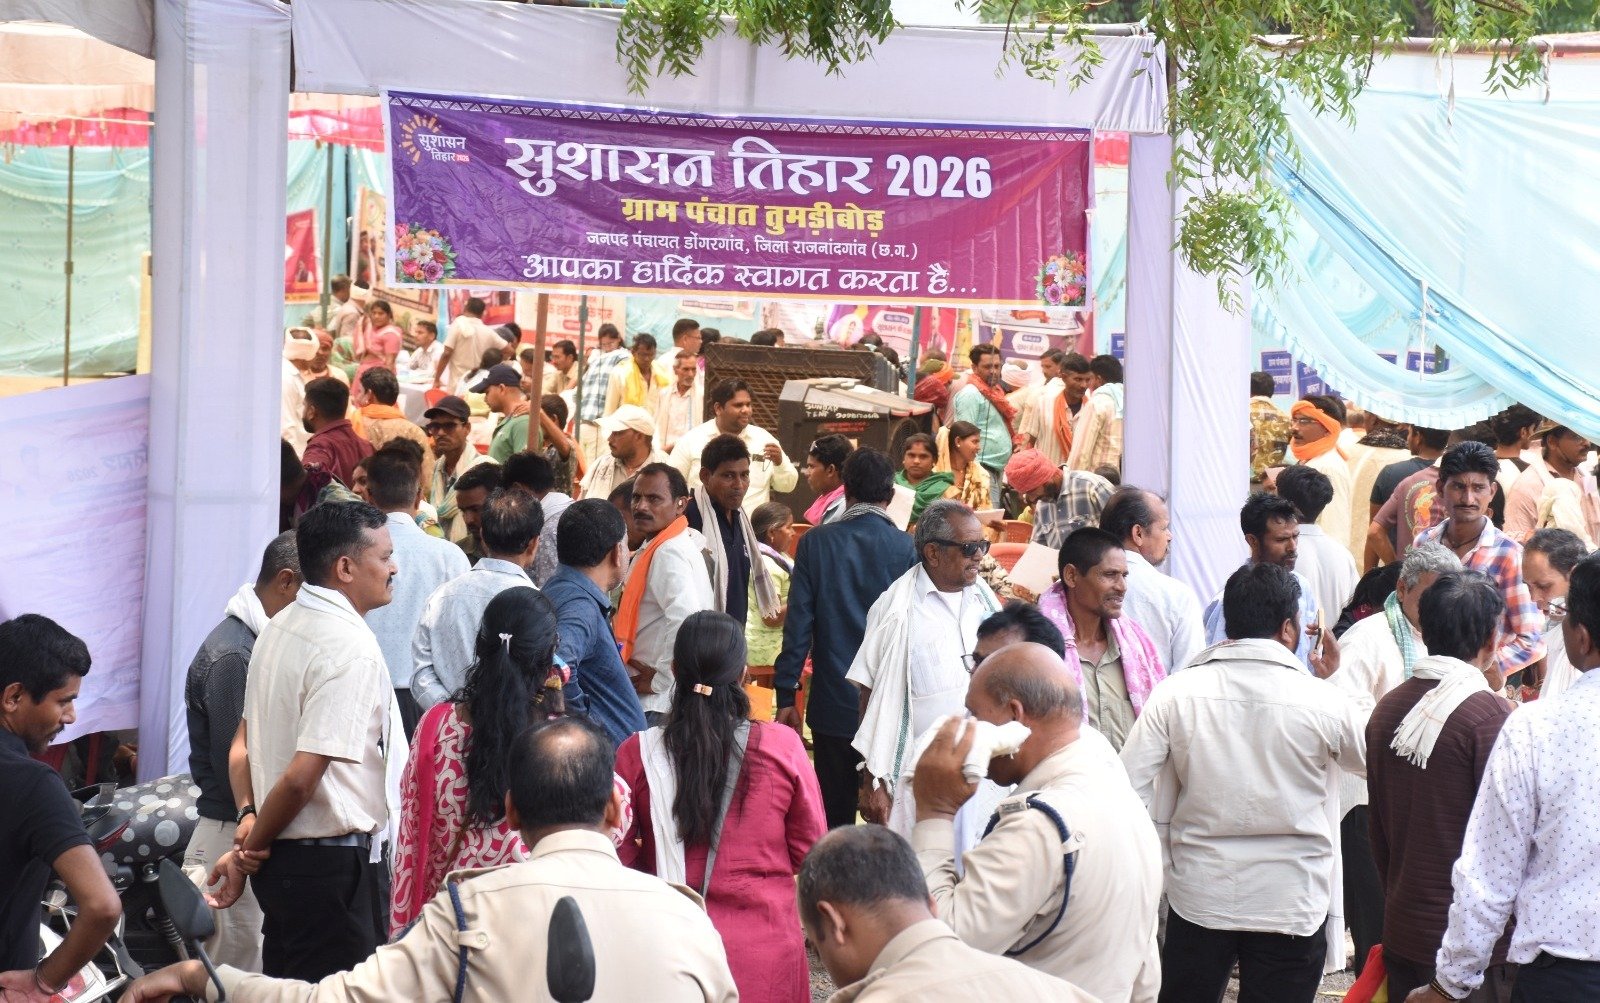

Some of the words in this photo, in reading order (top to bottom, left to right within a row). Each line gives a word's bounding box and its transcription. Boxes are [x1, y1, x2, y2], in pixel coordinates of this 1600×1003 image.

[418, 133, 466, 151] सुशासन
[431, 147, 456, 162] तिहार
[505, 137, 715, 197] सुशासन
[728, 136, 873, 195] तिहार
[886, 154, 992, 199] 2026
[621, 198, 679, 222] ग्राम
[685, 196, 759, 226] पंचात
[764, 201, 885, 238] तुमड़ीबोड़
[586, 231, 629, 247] जनपद
[632, 230, 680, 249] पंचायत
[684, 231, 750, 255] डोंगरगांव,
[754, 234, 789, 254] जिला
[793, 238, 867, 256] राजनांदगांव
[871, 241, 918, 260] (छ.ग.)
[521, 253, 624, 280] आपका
[631, 253, 726, 285] हार्दिक
[733, 264, 831, 291] स्वागत
[838, 268, 920, 294] करता
